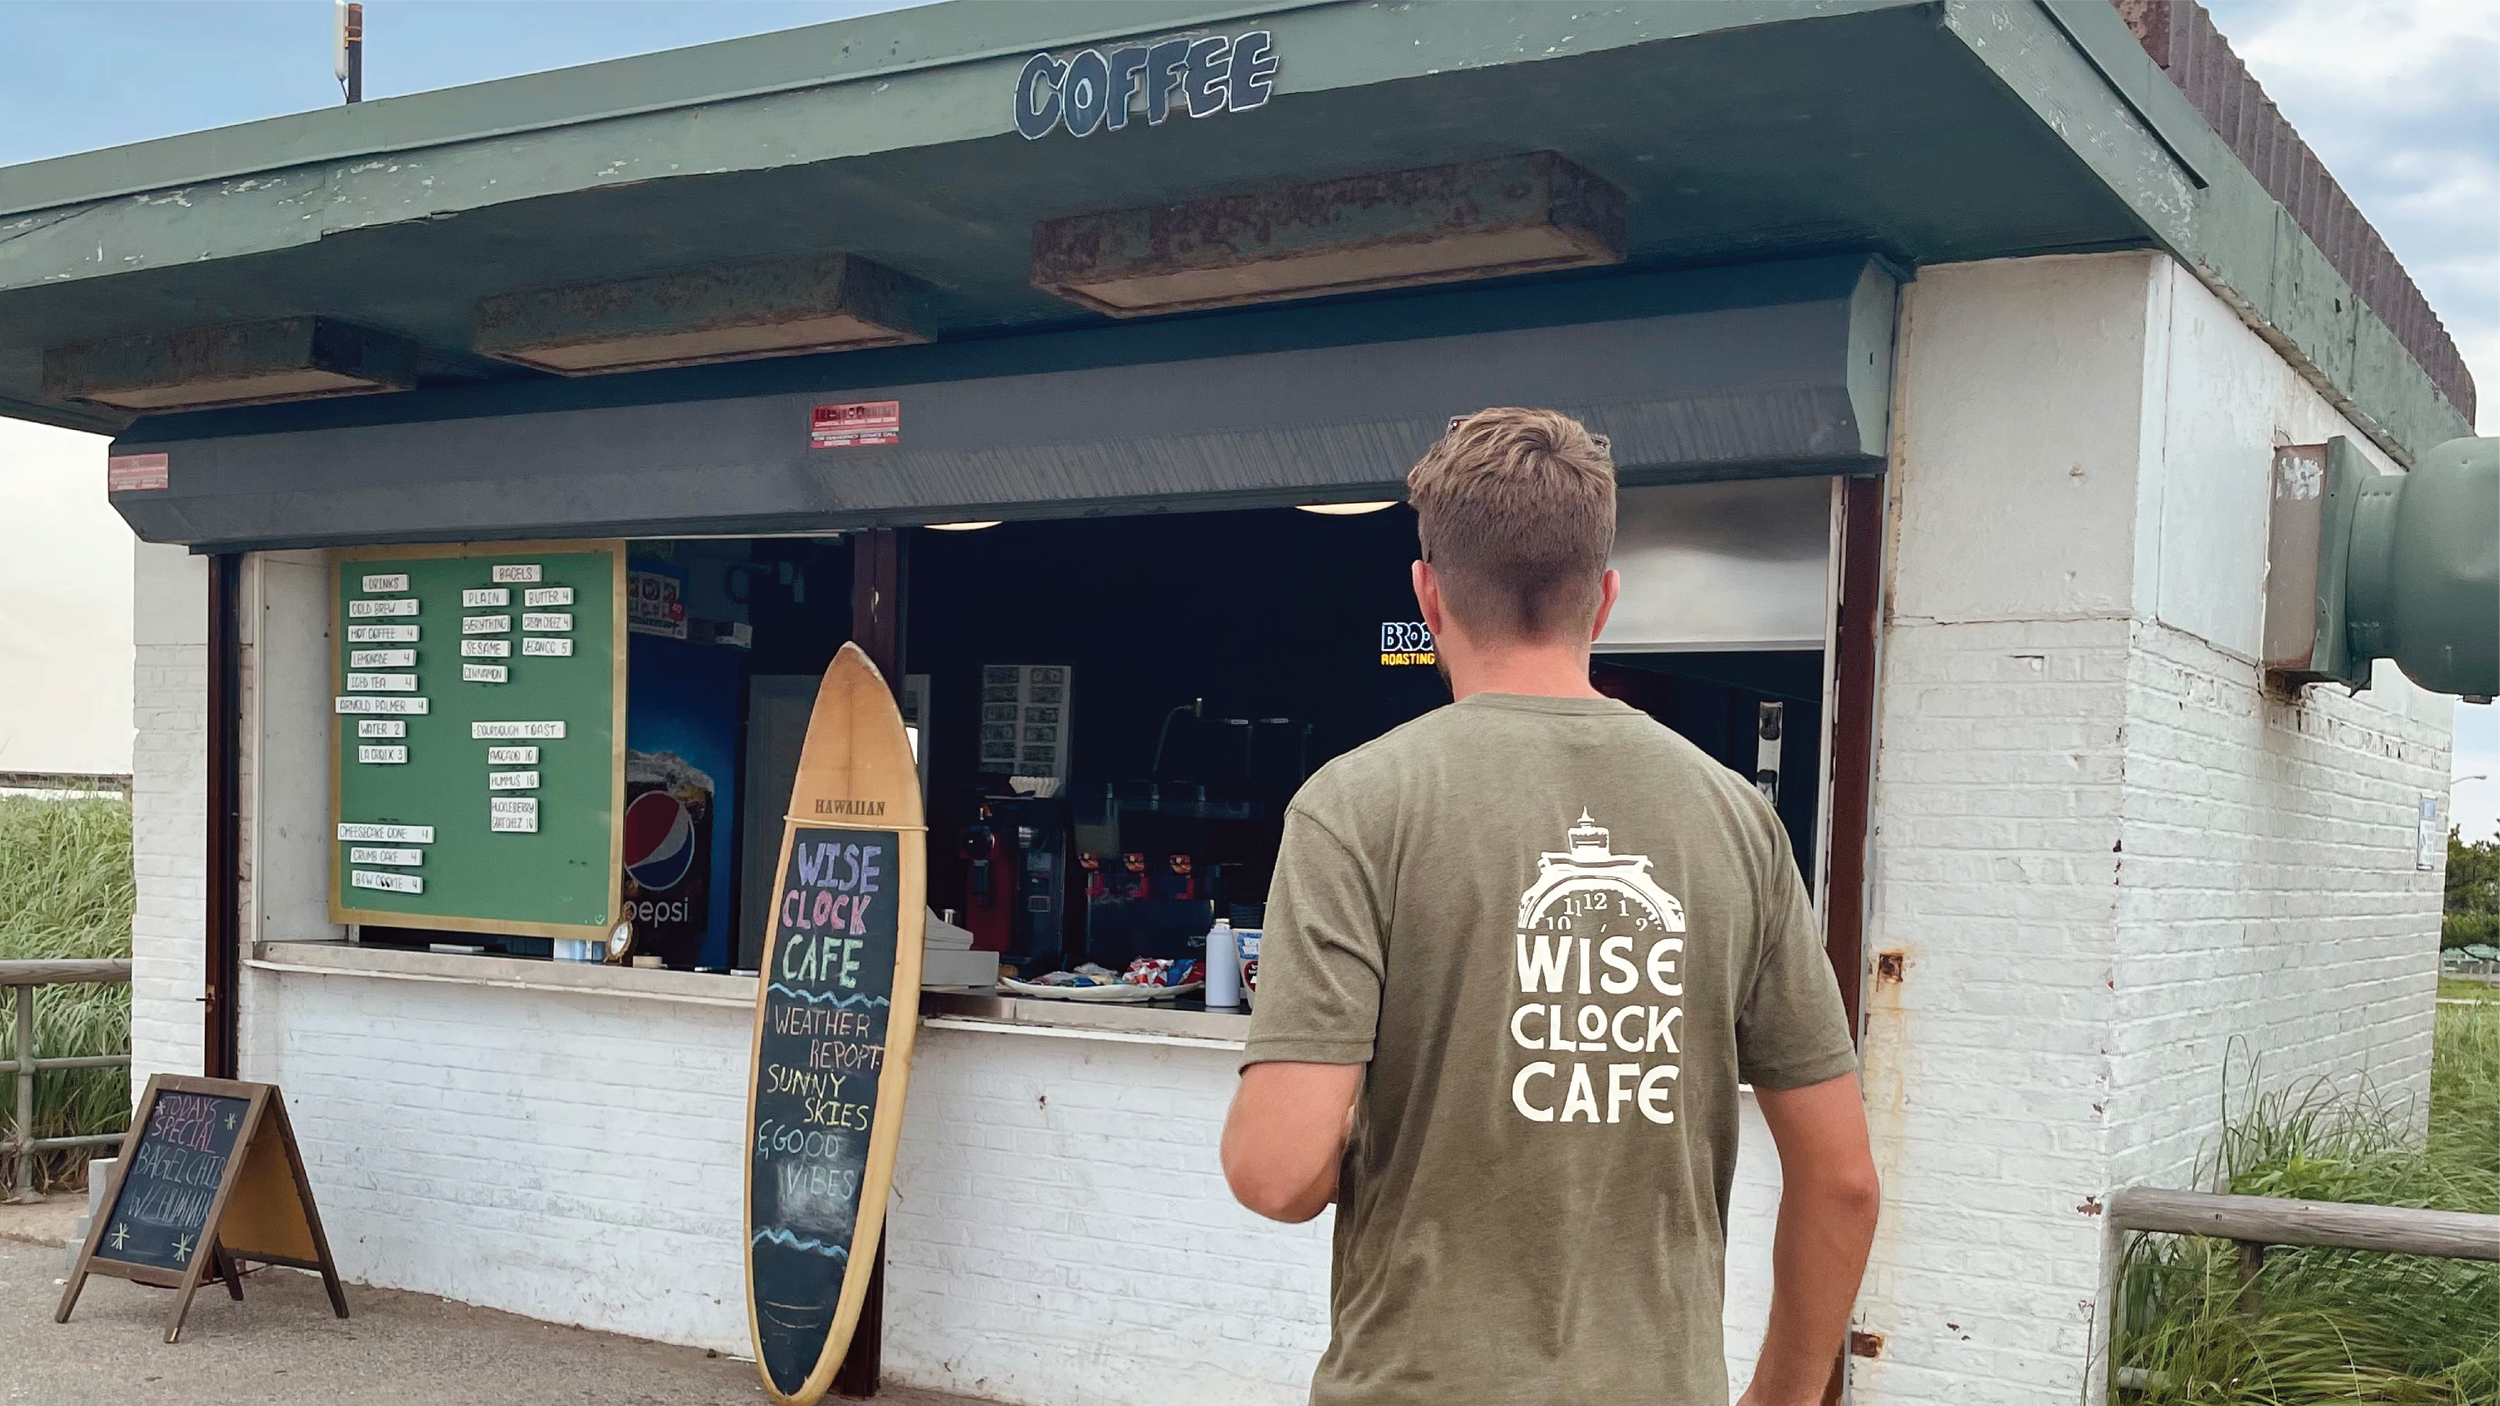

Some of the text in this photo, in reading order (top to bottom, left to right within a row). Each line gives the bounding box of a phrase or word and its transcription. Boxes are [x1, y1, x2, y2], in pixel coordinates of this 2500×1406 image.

[1013, 31, 1280, 140] COFFEE
[499, 567, 533, 581] BAGELS
[368, 577, 400, 590] DRINKS
[468, 591, 500, 604] PLAIN
[528, 590, 569, 604] BUTTER 4
[351, 601, 413, 615] COLD BREW 5
[463, 617, 507, 631] EVERYTHING
[563, 616, 569, 628] 4
[350, 627, 414, 640] HOT COFFEE 4
[465, 640, 502, 655] SESAME
[524, 640, 544, 653] VEGAN
[561, 642, 568, 654] 5
[353, 652, 410, 665] LEMONADE 4
[1381, 652, 1436, 666] ROASTING
[464, 666, 503, 680] CINNAMON
[350, 676, 412, 689] ICED TEA 4
[340, 699, 424, 712] ARNOLD PALMER 4
[360, 723, 401, 736] WATER 2
[476, 723, 556, 737] SOURDOUGH TOAST
[360, 748, 404, 761] LA CROIX 3
[489, 749, 534, 762] AVOCADO 10
[491, 774, 536, 787] HUMMUS 10
[491, 801, 535, 814] HUCKLEBERRY
[814, 799, 886, 816] HAWAIIAN
[339, 825, 385, 839] CHEESECAKE
[421, 829, 429, 840] 4
[353, 849, 418, 863] CRUMB CAKE 4
[798, 842, 882, 894] WISE
[375, 874, 404, 890] COOKIE
[412, 879, 418, 889] 4
[1583, 892, 1608, 910] 12
[1618, 899, 1630, 916] 1
[782, 889, 872, 935] CLOCK
[782, 934, 864, 989] CAFE
[1515, 933, 1685, 996] WISE
[774, 1005, 871, 1039] WEATHER
[1510, 1003, 1684, 1053] CLOCK
[767, 1063, 847, 1099] SUNNY
[1511, 1061, 1681, 1125] CAFE
[164, 1095, 221, 1124] TODAYS
[803, 1097, 870, 1131] SKIES
[151, 1115, 216, 1154] SPECIAL
[133, 1142, 226, 1189] BAGEL CHIP
[787, 1163, 855, 1200] VIBES
[156, 1187, 213, 1228] HUMMU
